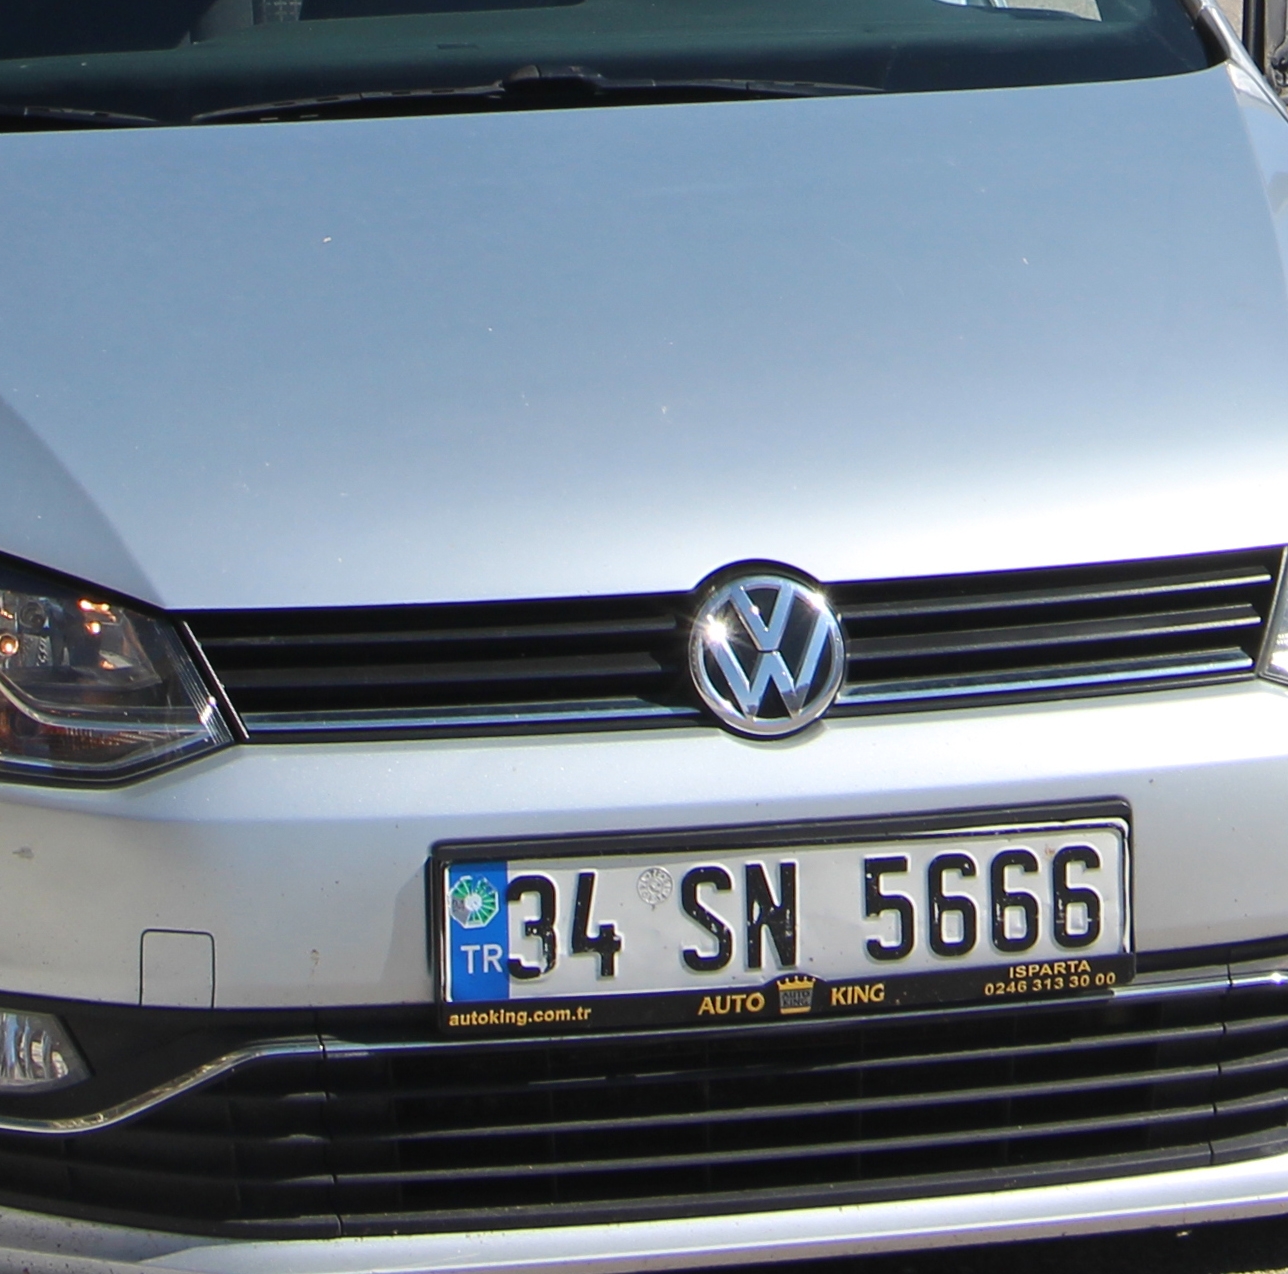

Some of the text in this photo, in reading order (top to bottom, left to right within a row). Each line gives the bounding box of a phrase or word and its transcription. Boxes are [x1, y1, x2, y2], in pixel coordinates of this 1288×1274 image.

[506, 844, 1101, 980] 34 SN 5666
[460, 943, 503, 975] TR
[1009, 959, 1092, 979] ISPARTA
[984, 971, 1117, 996] 0246 313 30 00
[698, 983, 886, 1016] AUTO KING
[448, 1005, 592, 1027] autoking.com.tr
